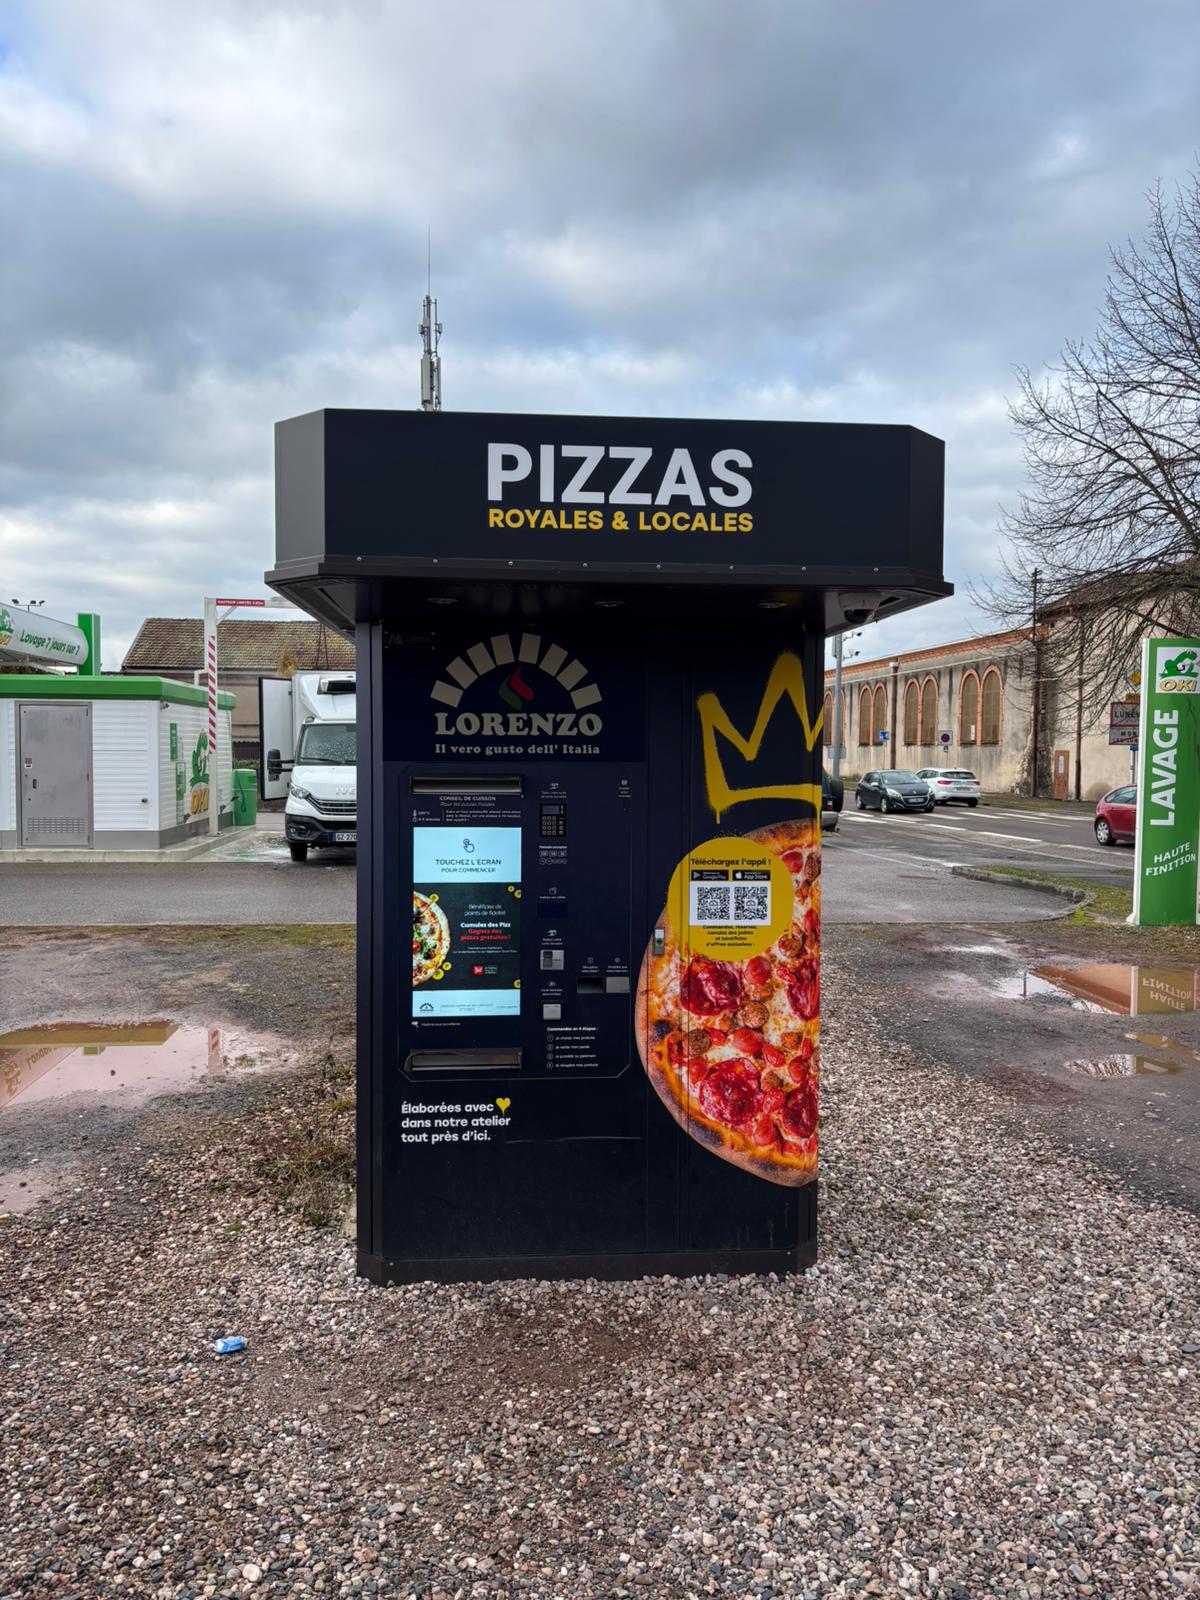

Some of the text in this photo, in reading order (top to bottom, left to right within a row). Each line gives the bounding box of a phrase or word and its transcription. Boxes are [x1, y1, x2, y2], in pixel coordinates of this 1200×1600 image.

[487, 443, 753, 507] PIZZAS
[488, 508, 753, 532] ROYALES & LOCALES
[20, 628, 46, 648] Lavage
[46, 637, 51, 649] 7
[50, 638, 66, 652] jours
[66, 644, 76, 655] sur
[1159, 679, 1198, 692] OKI
[435, 712, 603, 736] LORENZO
[435, 744, 600, 756] Il vero gusto dell' Italia
[1150, 709, 1179, 826] LAVAGE
[691, 857, 740, 867] Téléchargez
[741, 858, 767, 867] l'appli
[1154, 842, 1190, 863] HAUTE
[1145, 853, 1196, 876] FINITION
[401, 1101, 494, 1114] Élaborées avec
[401, 1115, 511, 1128] dans notre atelier
[400, 1130, 491, 1145] tout près d'ici.
